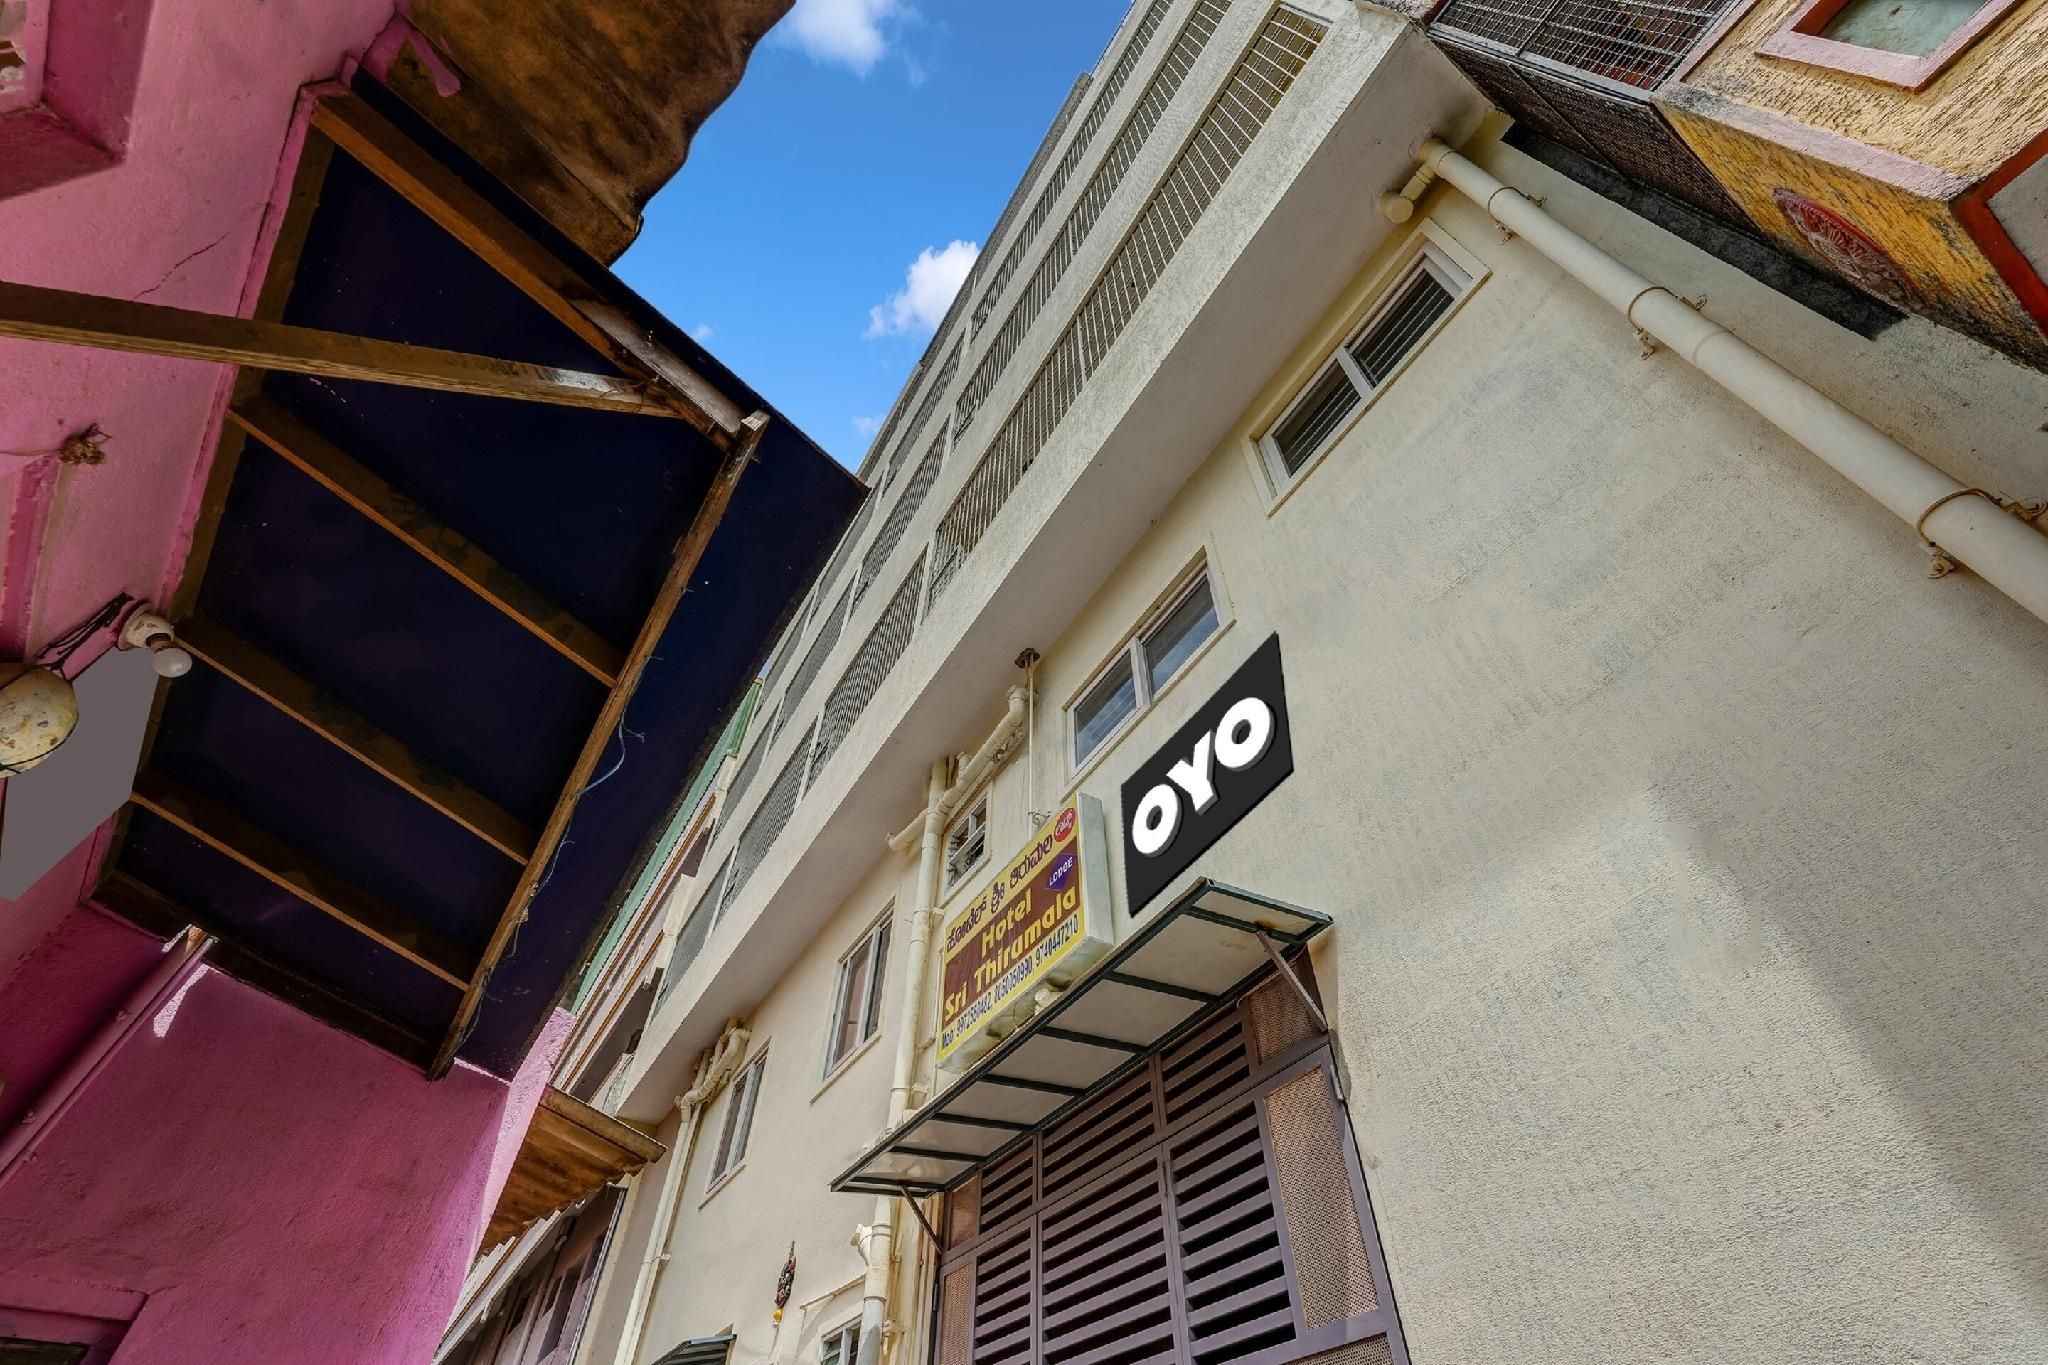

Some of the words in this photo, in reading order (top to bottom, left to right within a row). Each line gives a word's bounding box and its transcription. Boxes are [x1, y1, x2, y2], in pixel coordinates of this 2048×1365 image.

[1132, 697, 1275, 858] OYO
[1049, 856, 1074, 886] LODGE
[944, 981, 967, 1022] Sri
[974, 886, 1076, 993] Thiramala
[981, 888, 1032, 958] Hotel
